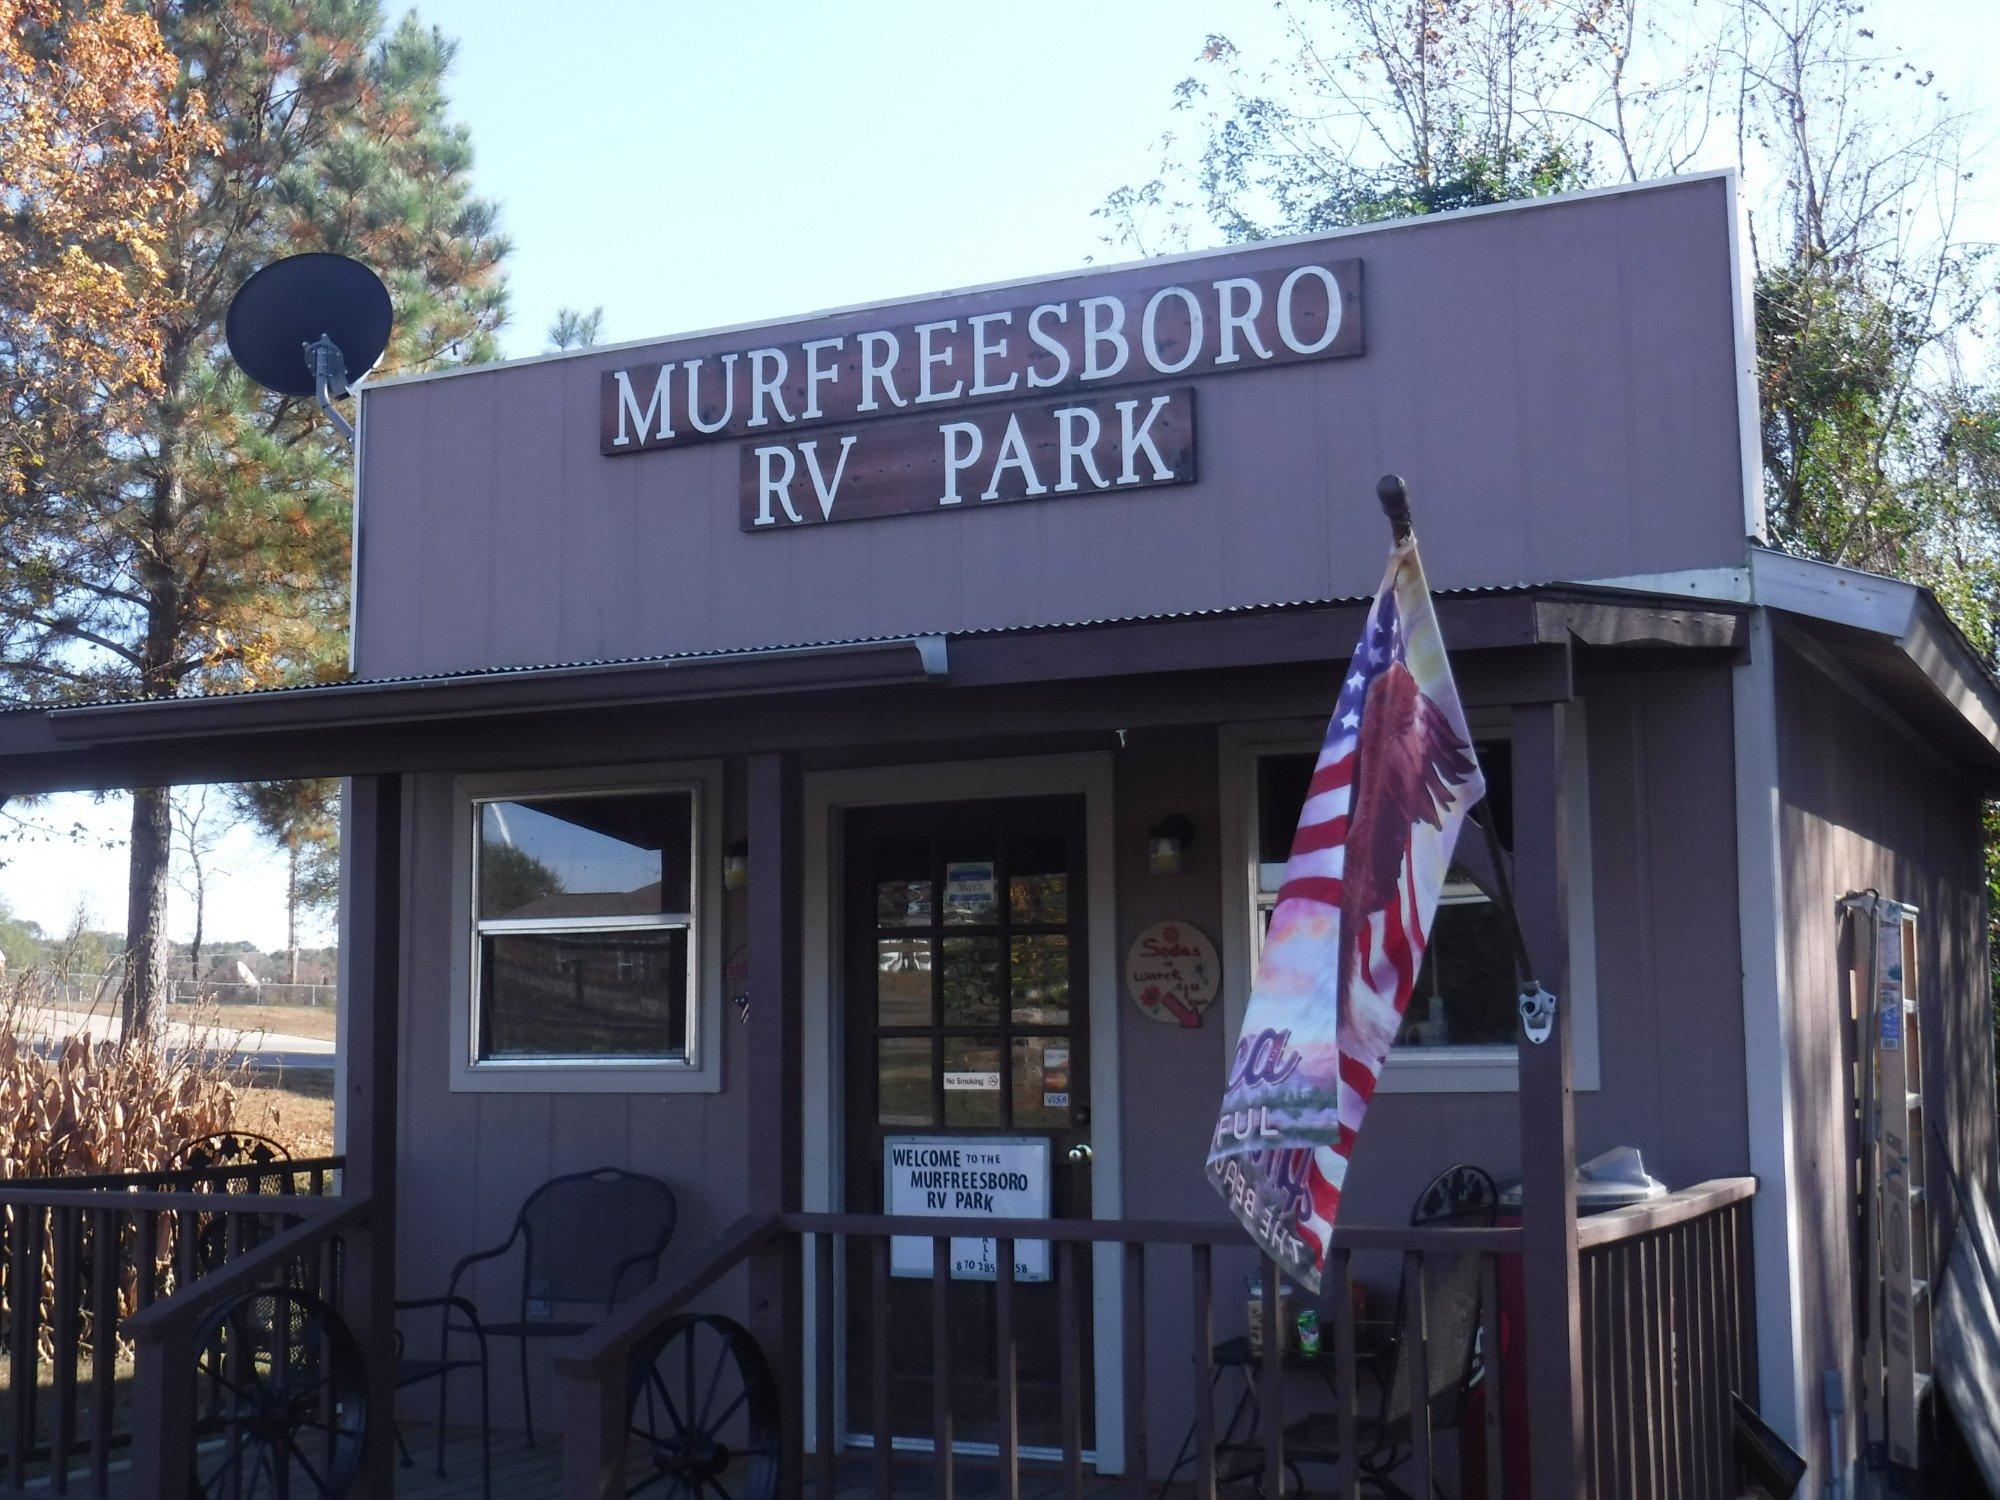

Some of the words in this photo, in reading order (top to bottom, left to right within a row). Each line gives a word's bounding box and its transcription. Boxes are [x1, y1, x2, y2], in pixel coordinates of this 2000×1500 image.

[613, 265, 1342, 447] MURFREESBORO
[753, 436, 857, 526] RV
[939, 396, 1174, 506] PARK
[946, 1077, 956, 1085] No
[956, 1077, 984, 1087] Smoking
[1046, 1095, 1067, 1104] VISA
[892, 1149, 961, 1168] WELCOME
[966, 1153, 978, 1164] TO
[981, 1154, 1001, 1164] THE
[910, 1170, 1028, 1192] MURFREESBORO
[927, 1190, 947, 1209] RV
[955, 1191, 994, 1213] PARK
